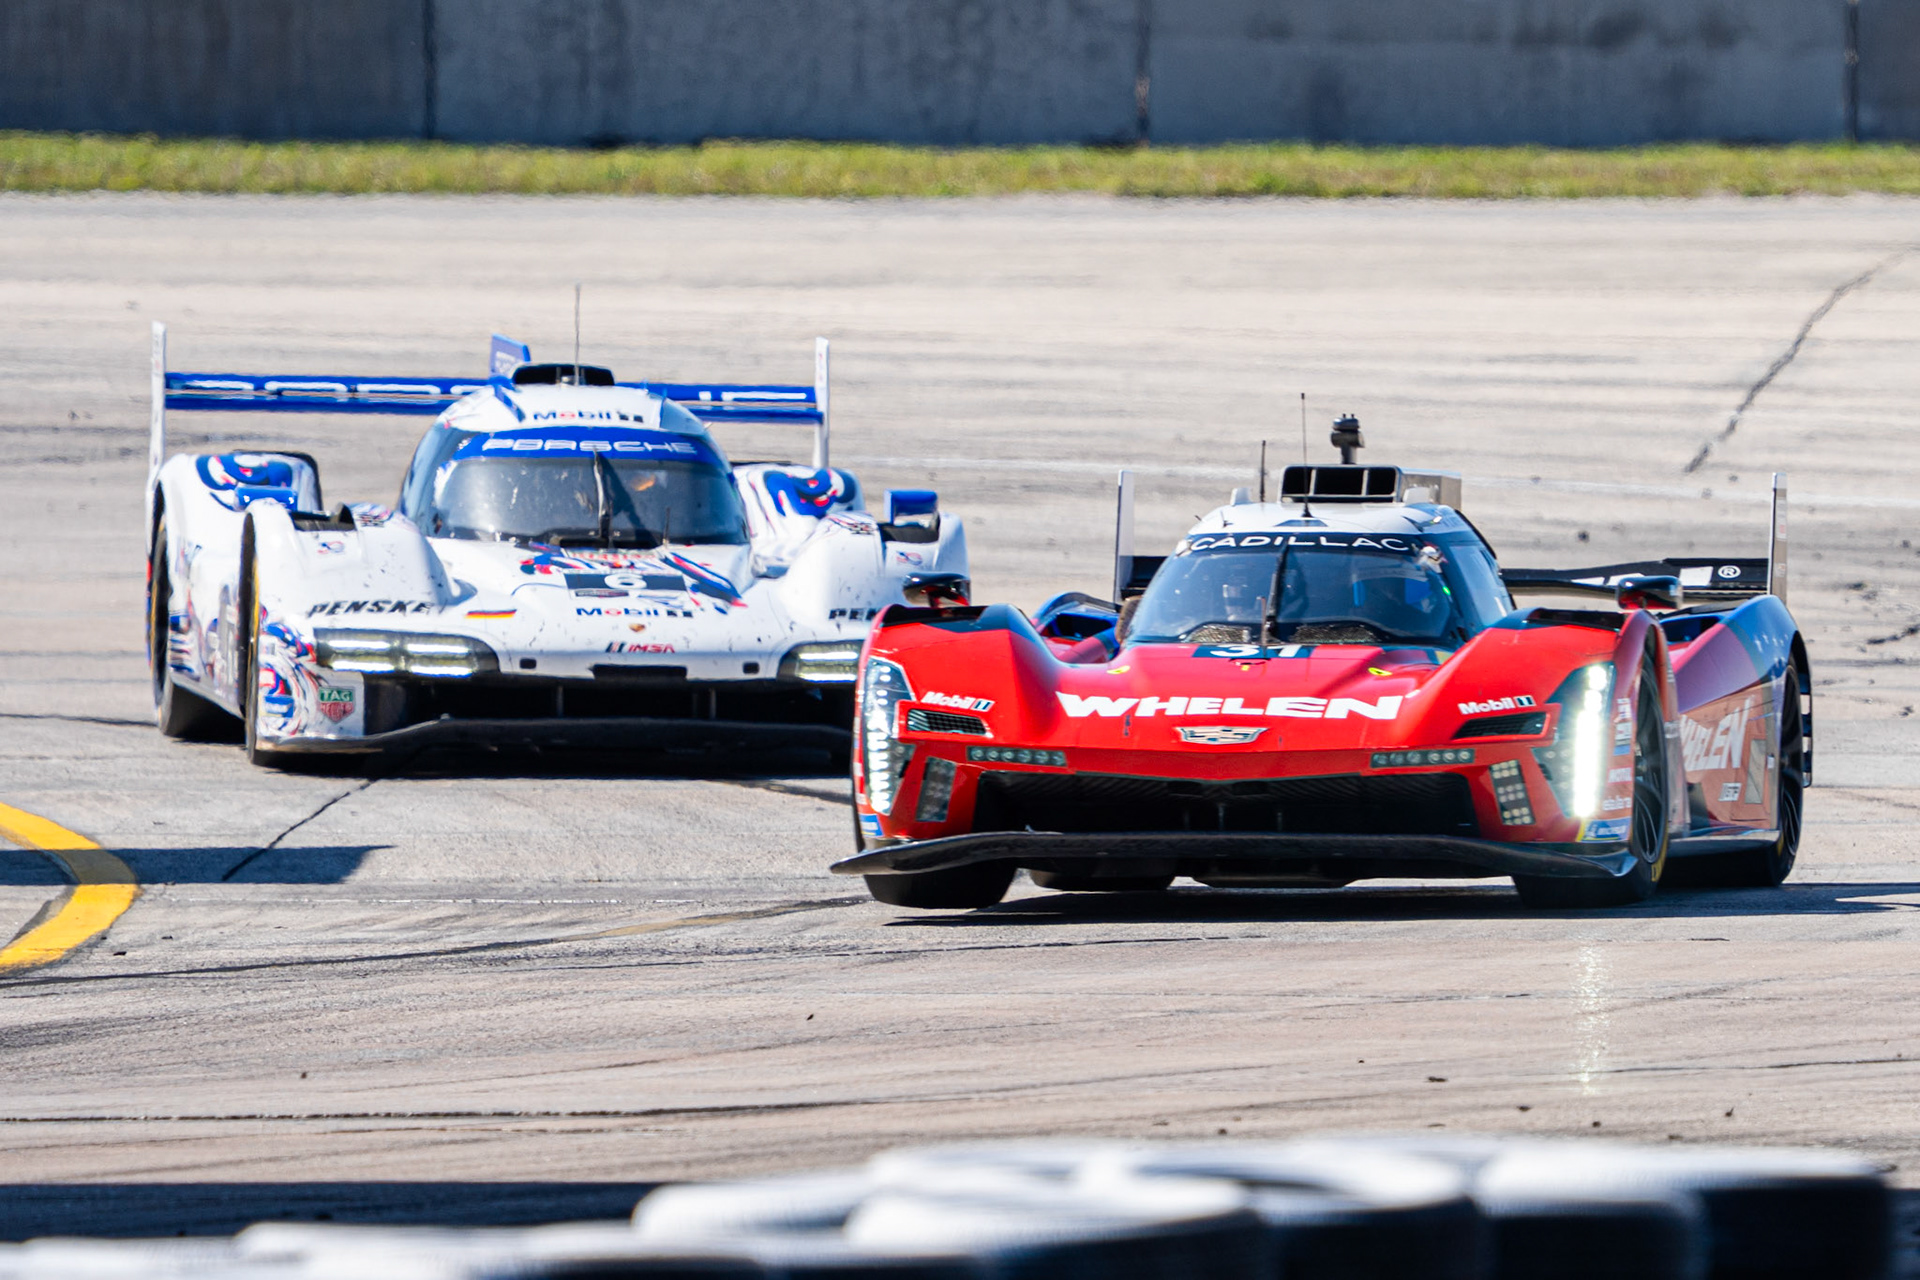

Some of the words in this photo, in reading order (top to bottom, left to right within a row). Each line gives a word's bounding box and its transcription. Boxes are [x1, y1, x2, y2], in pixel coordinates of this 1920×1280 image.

[482, 438, 697, 455] PORSCHE
[1189, 536, 1410, 552] CADILLAC
[604, 574, 648, 590] 6
[307, 600, 434, 617] PENSKE
[575, 607, 660, 617] Mobil
[627, 644, 676, 654] IMSA
[1210, 644, 1303, 658] 31
[322, 690, 352, 701] TAG
[920, 691, 974, 709] Mobil
[1055, 692, 1404, 719] WHELEN
[1457, 697, 1516, 715] Mobil
